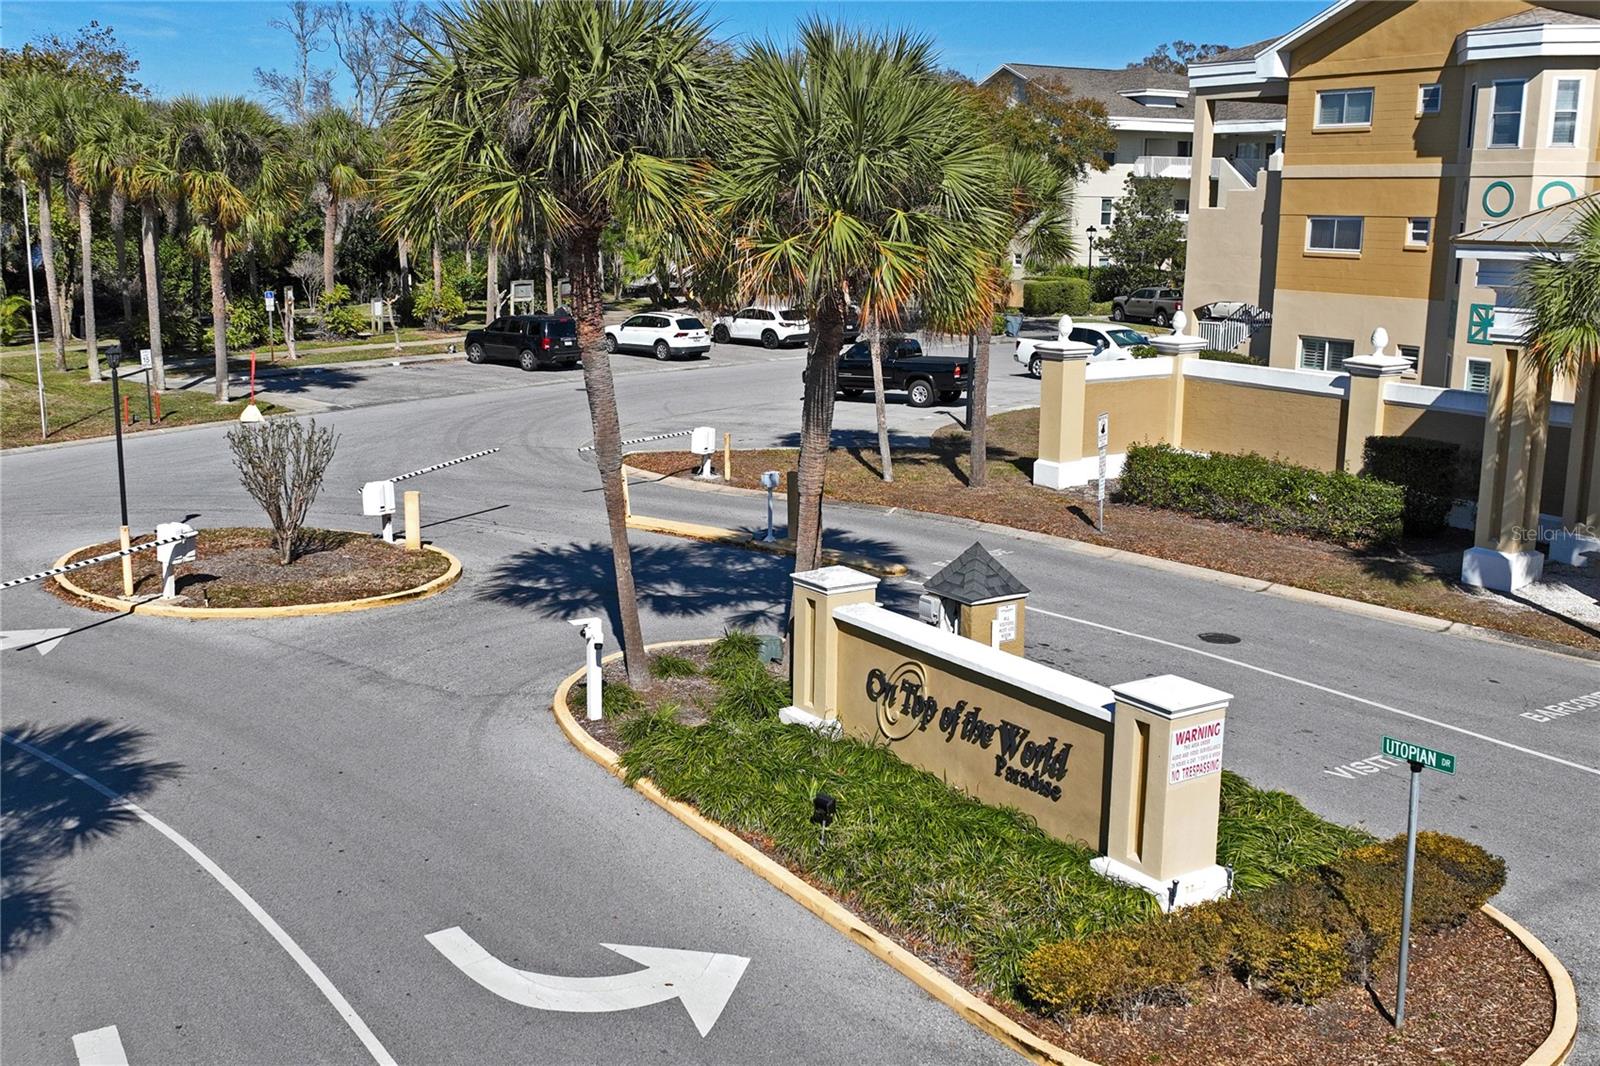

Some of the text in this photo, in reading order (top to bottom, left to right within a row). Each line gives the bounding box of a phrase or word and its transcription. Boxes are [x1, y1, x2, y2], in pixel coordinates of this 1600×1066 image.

[866, 668, 1073, 782] On Top of the World
[1175, 722, 1221, 745] WARNING
[1386, 738, 1451, 768] UTOPIAN DR
[994, 754, 1062, 803] Paradise
[1171, 759, 1219, 781] NO TRESPASSING
